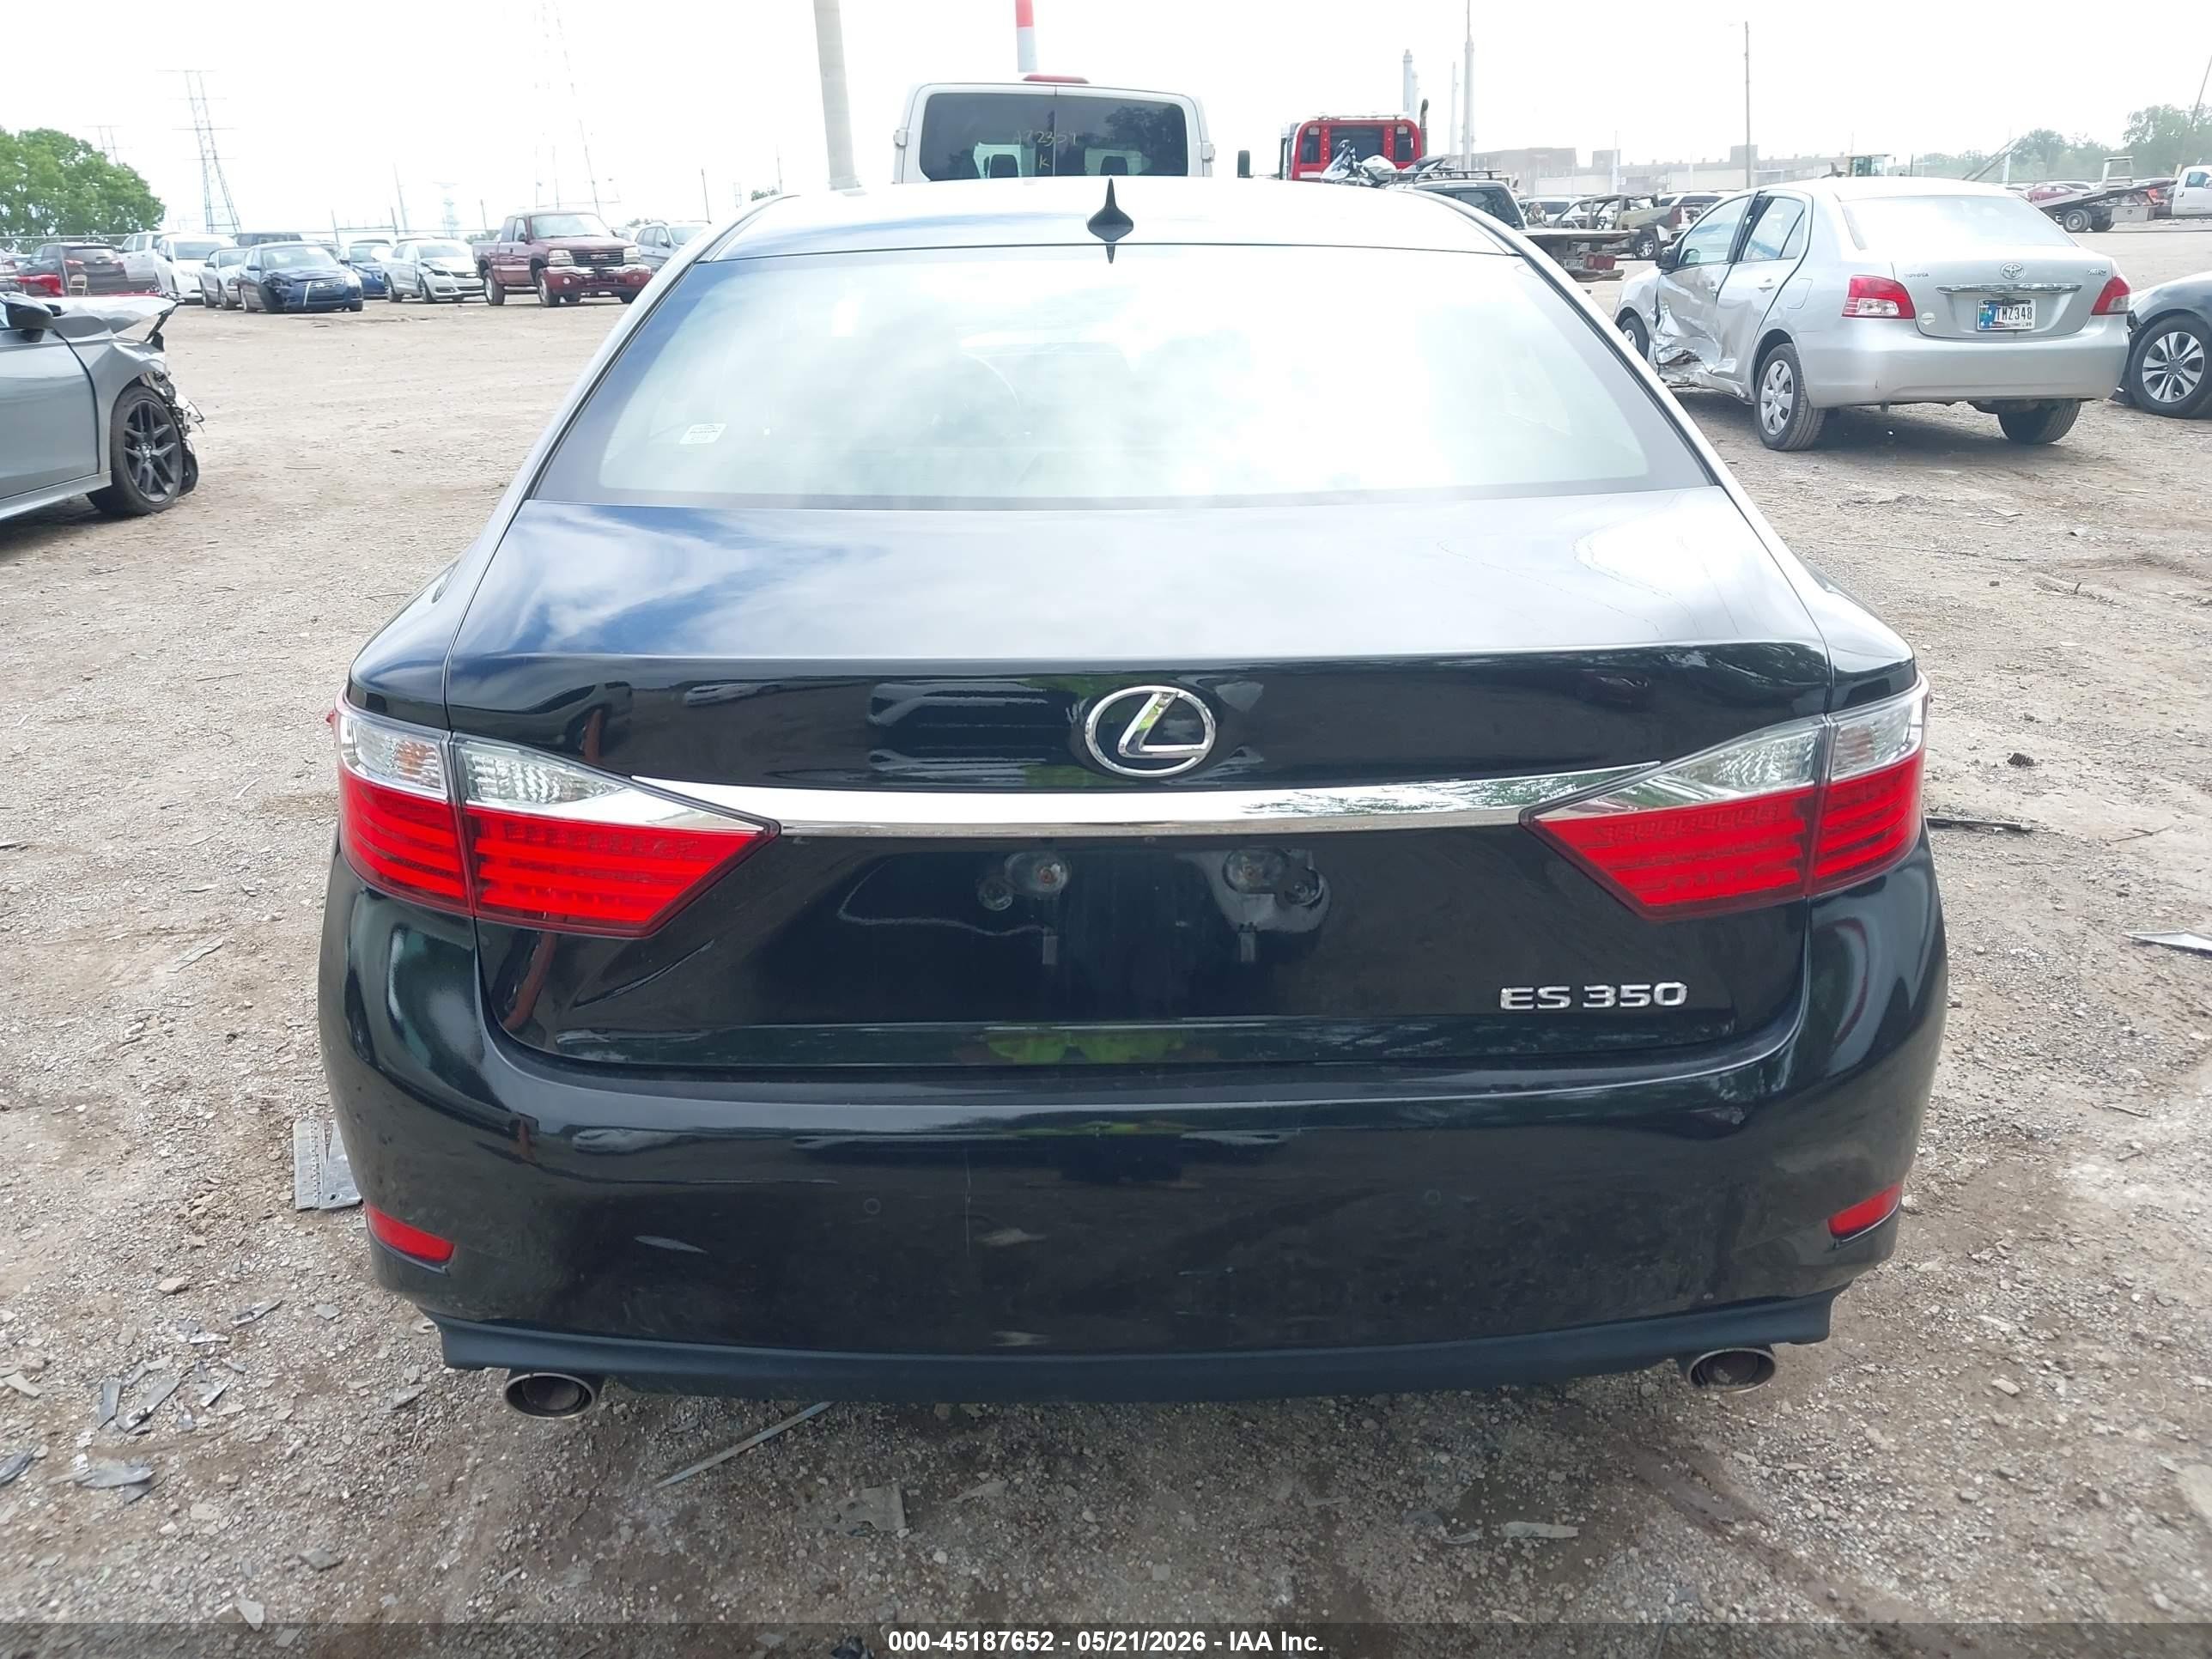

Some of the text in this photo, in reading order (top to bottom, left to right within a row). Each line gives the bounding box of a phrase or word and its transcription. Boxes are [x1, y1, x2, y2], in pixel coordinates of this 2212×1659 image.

[1996, 307, 2033, 320] TMZ348
[1500, 981, 1688, 1010] ES 350
